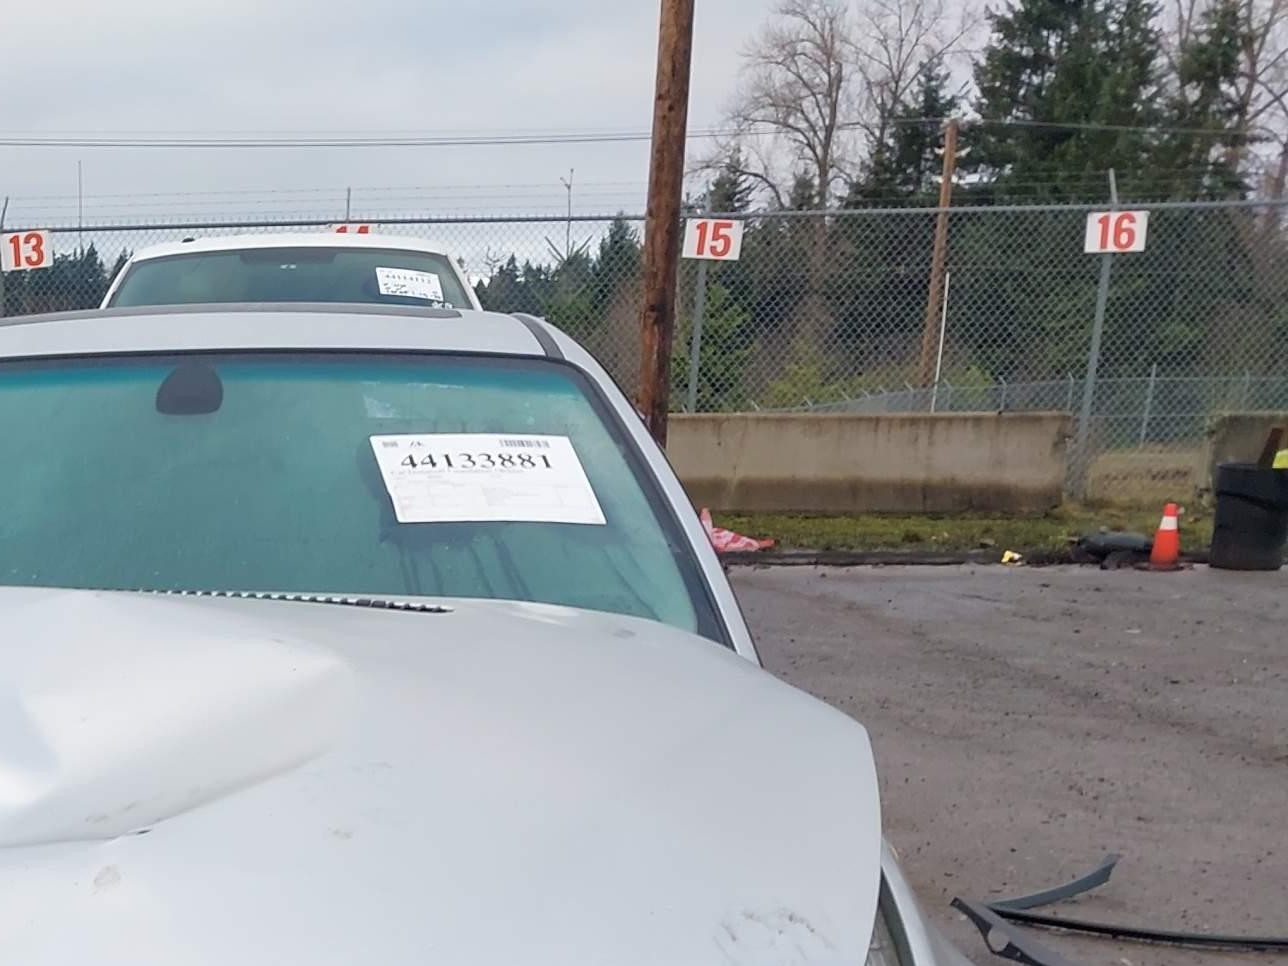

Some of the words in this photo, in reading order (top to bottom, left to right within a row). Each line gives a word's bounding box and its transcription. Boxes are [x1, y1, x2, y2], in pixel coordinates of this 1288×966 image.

[696, 221, 733, 257] 15
[1098, 212, 1136, 250] 16
[9, 232, 44, 268] 13
[400, 452, 553, 470] 44133881
